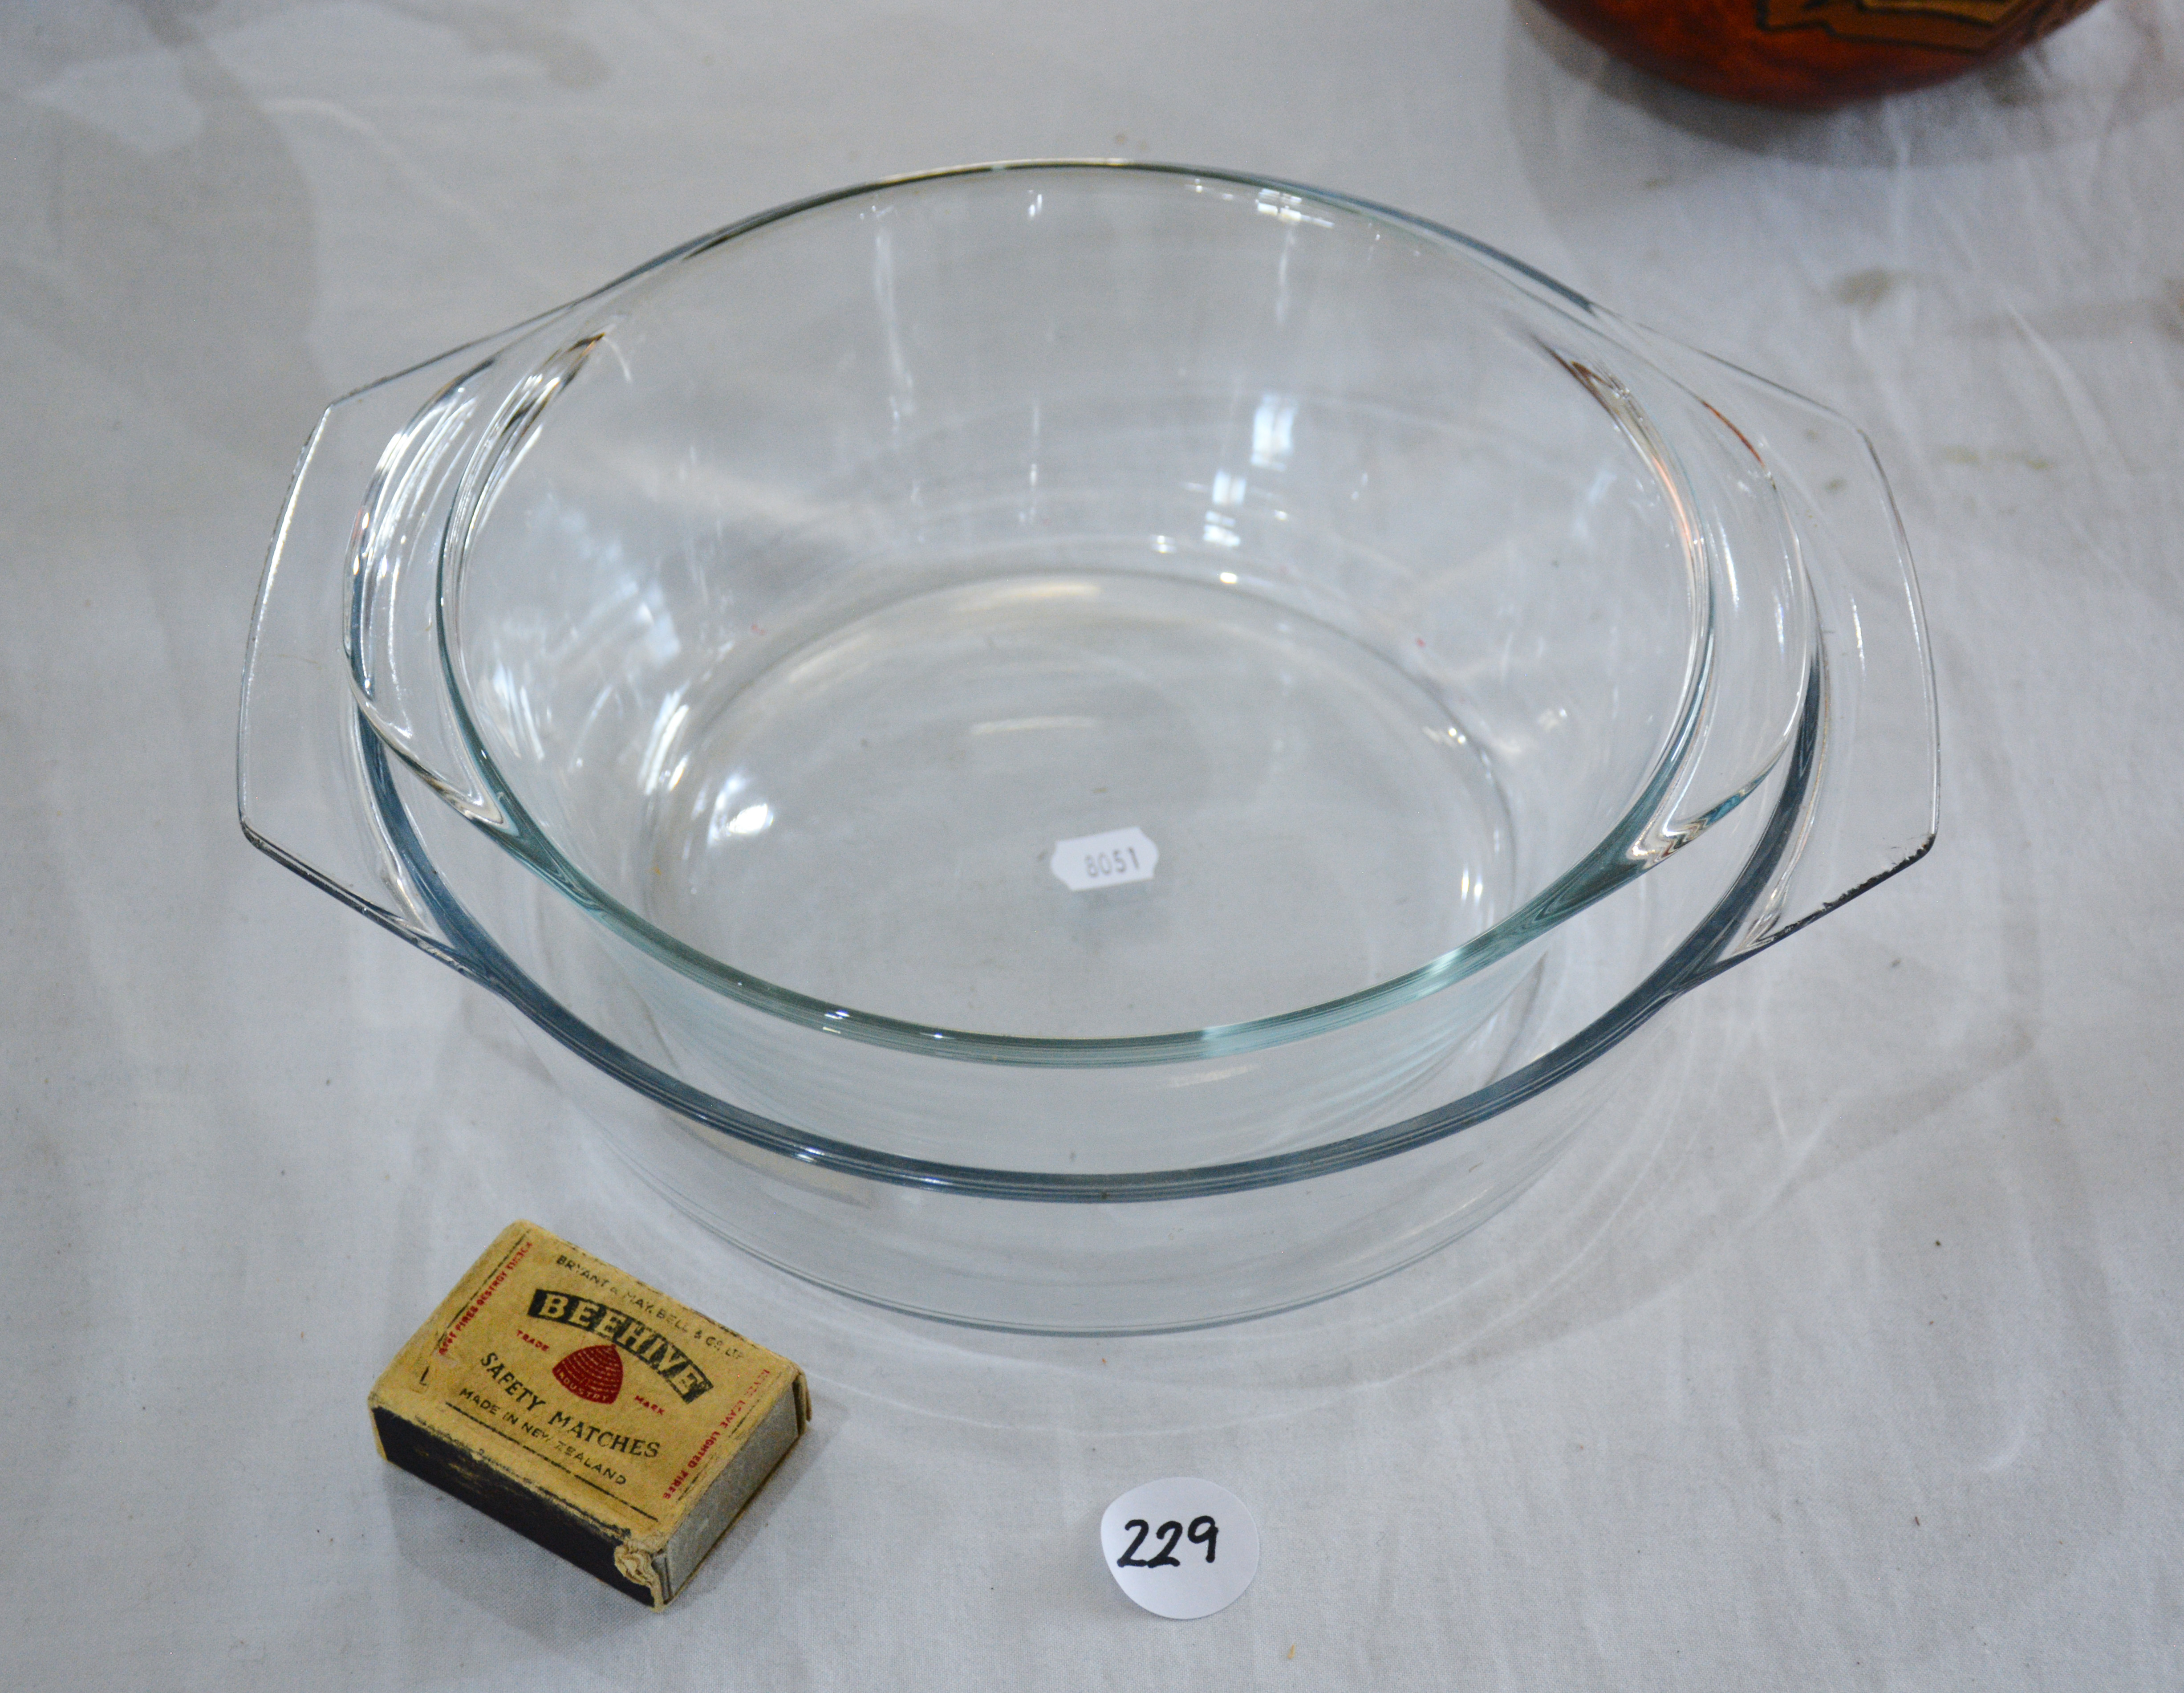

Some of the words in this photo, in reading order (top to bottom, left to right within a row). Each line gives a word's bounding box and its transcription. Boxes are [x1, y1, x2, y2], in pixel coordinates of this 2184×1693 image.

[1084, 846, 1140, 878] 8051
[556, 1254, 610, 1287] BRYANT
[516, 1329, 550, 1352] TRADE
[538, 1292, 706, 1395] BEEHIVE
[556, 1368, 609, 1401] INDUSTRY
[480, 1351, 547, 1412] SAFETY
[548, 1411, 661, 1458] MATCHES
[634, 1395, 666, 1416] MARK
[459, 1388, 501, 1415] MADE
[502, 1411, 519, 1425] IN
[521, 1422, 552, 1443] NEW
[553, 1440, 627, 1485] ZEALAND
[687, 1431, 721, 1469] LIGHTED
[1116, 1515, 1219, 1569] 229
